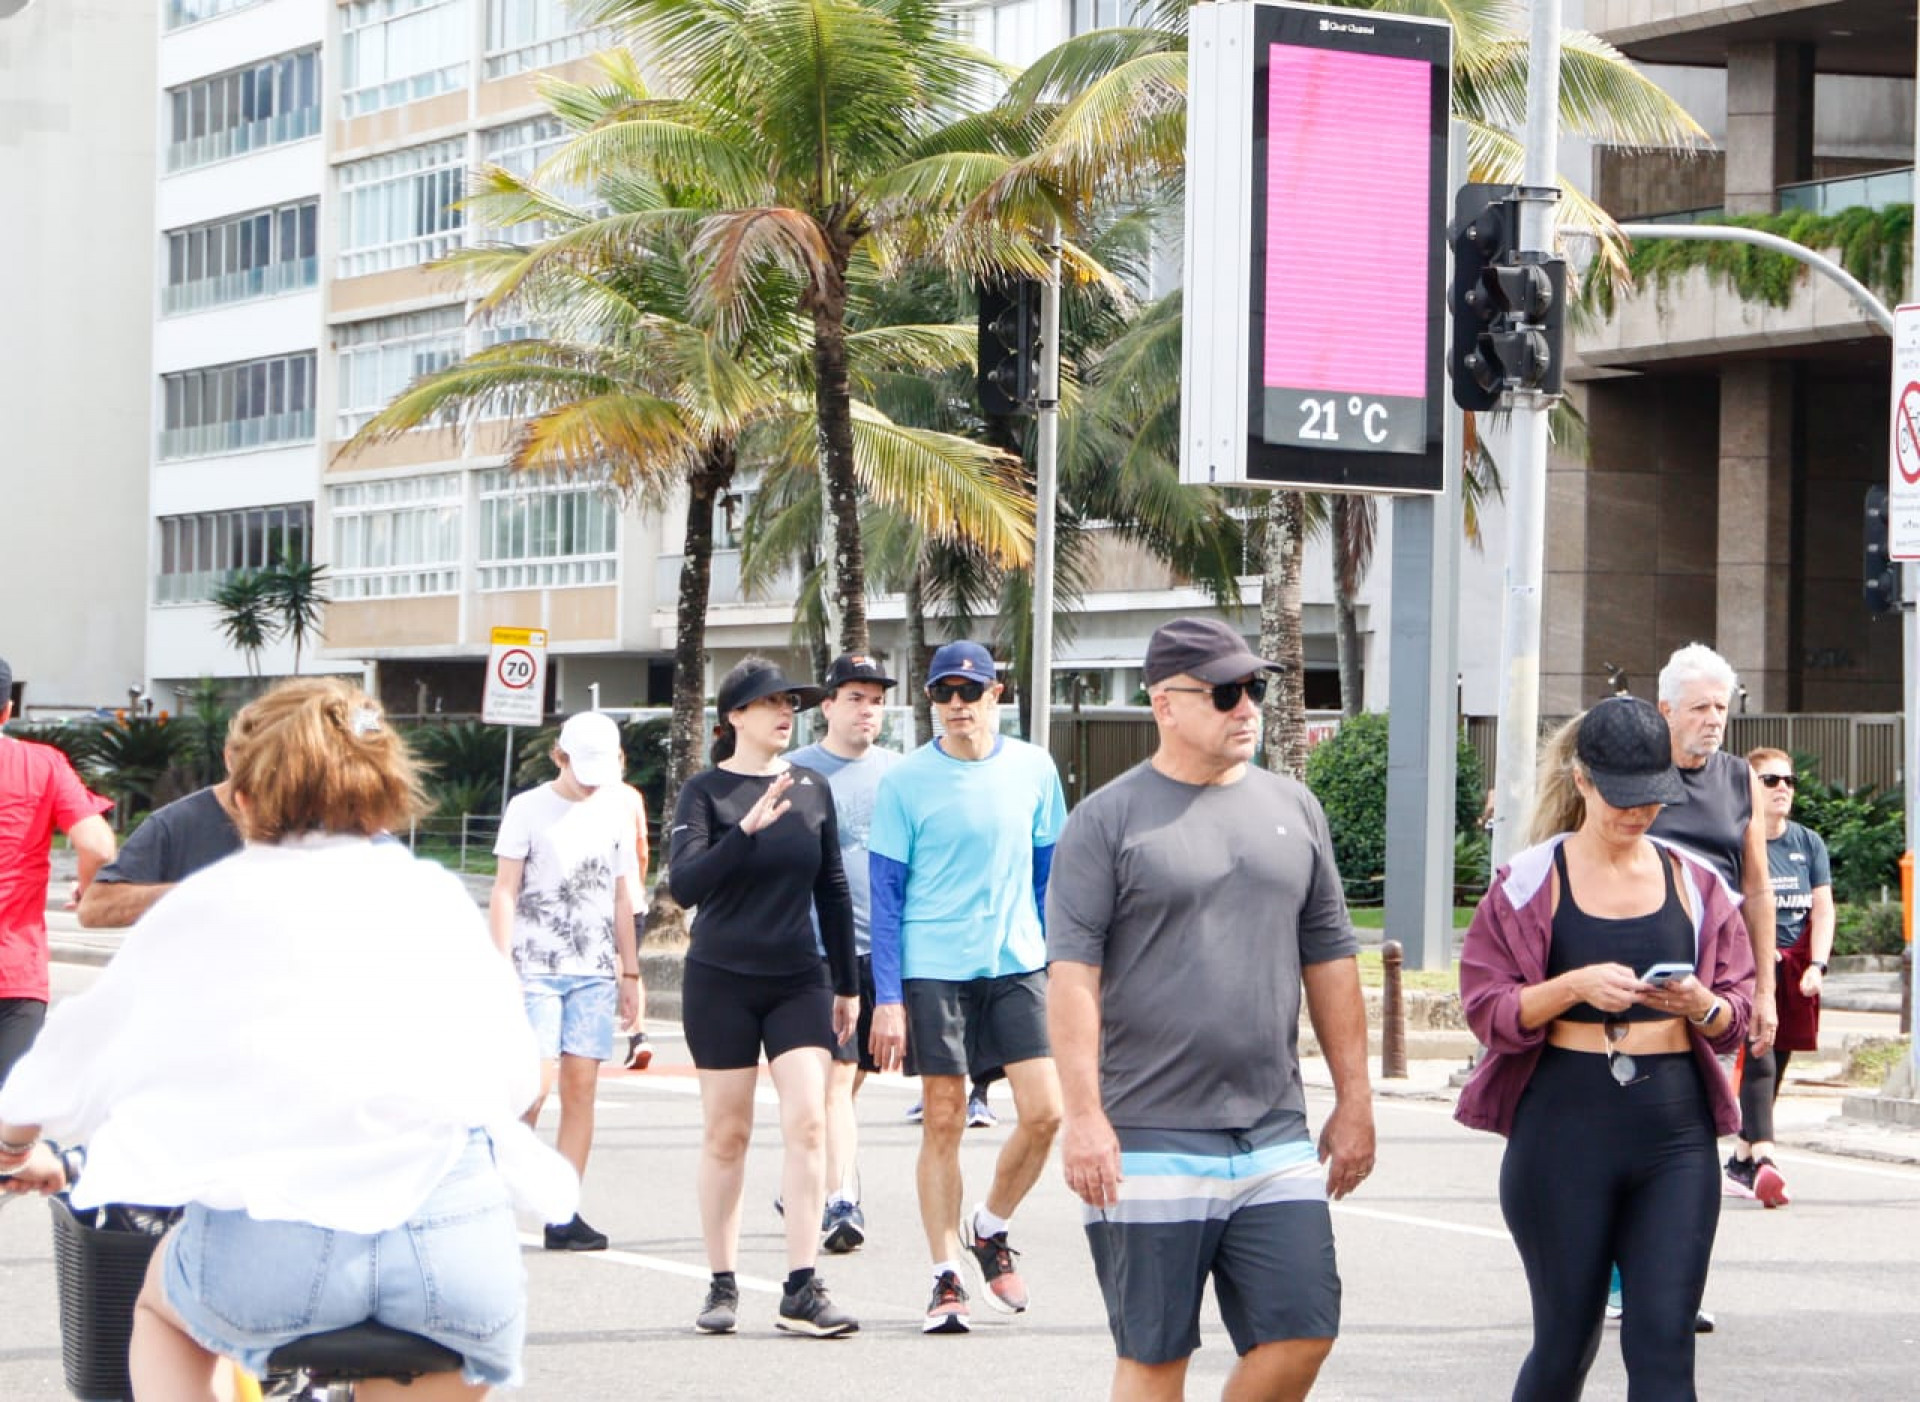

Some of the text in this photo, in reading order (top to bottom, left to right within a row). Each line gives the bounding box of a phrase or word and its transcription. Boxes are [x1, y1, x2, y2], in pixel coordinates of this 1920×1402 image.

[1298, 395, 1389, 443] 21 °C
[506, 662, 529, 677] 70
